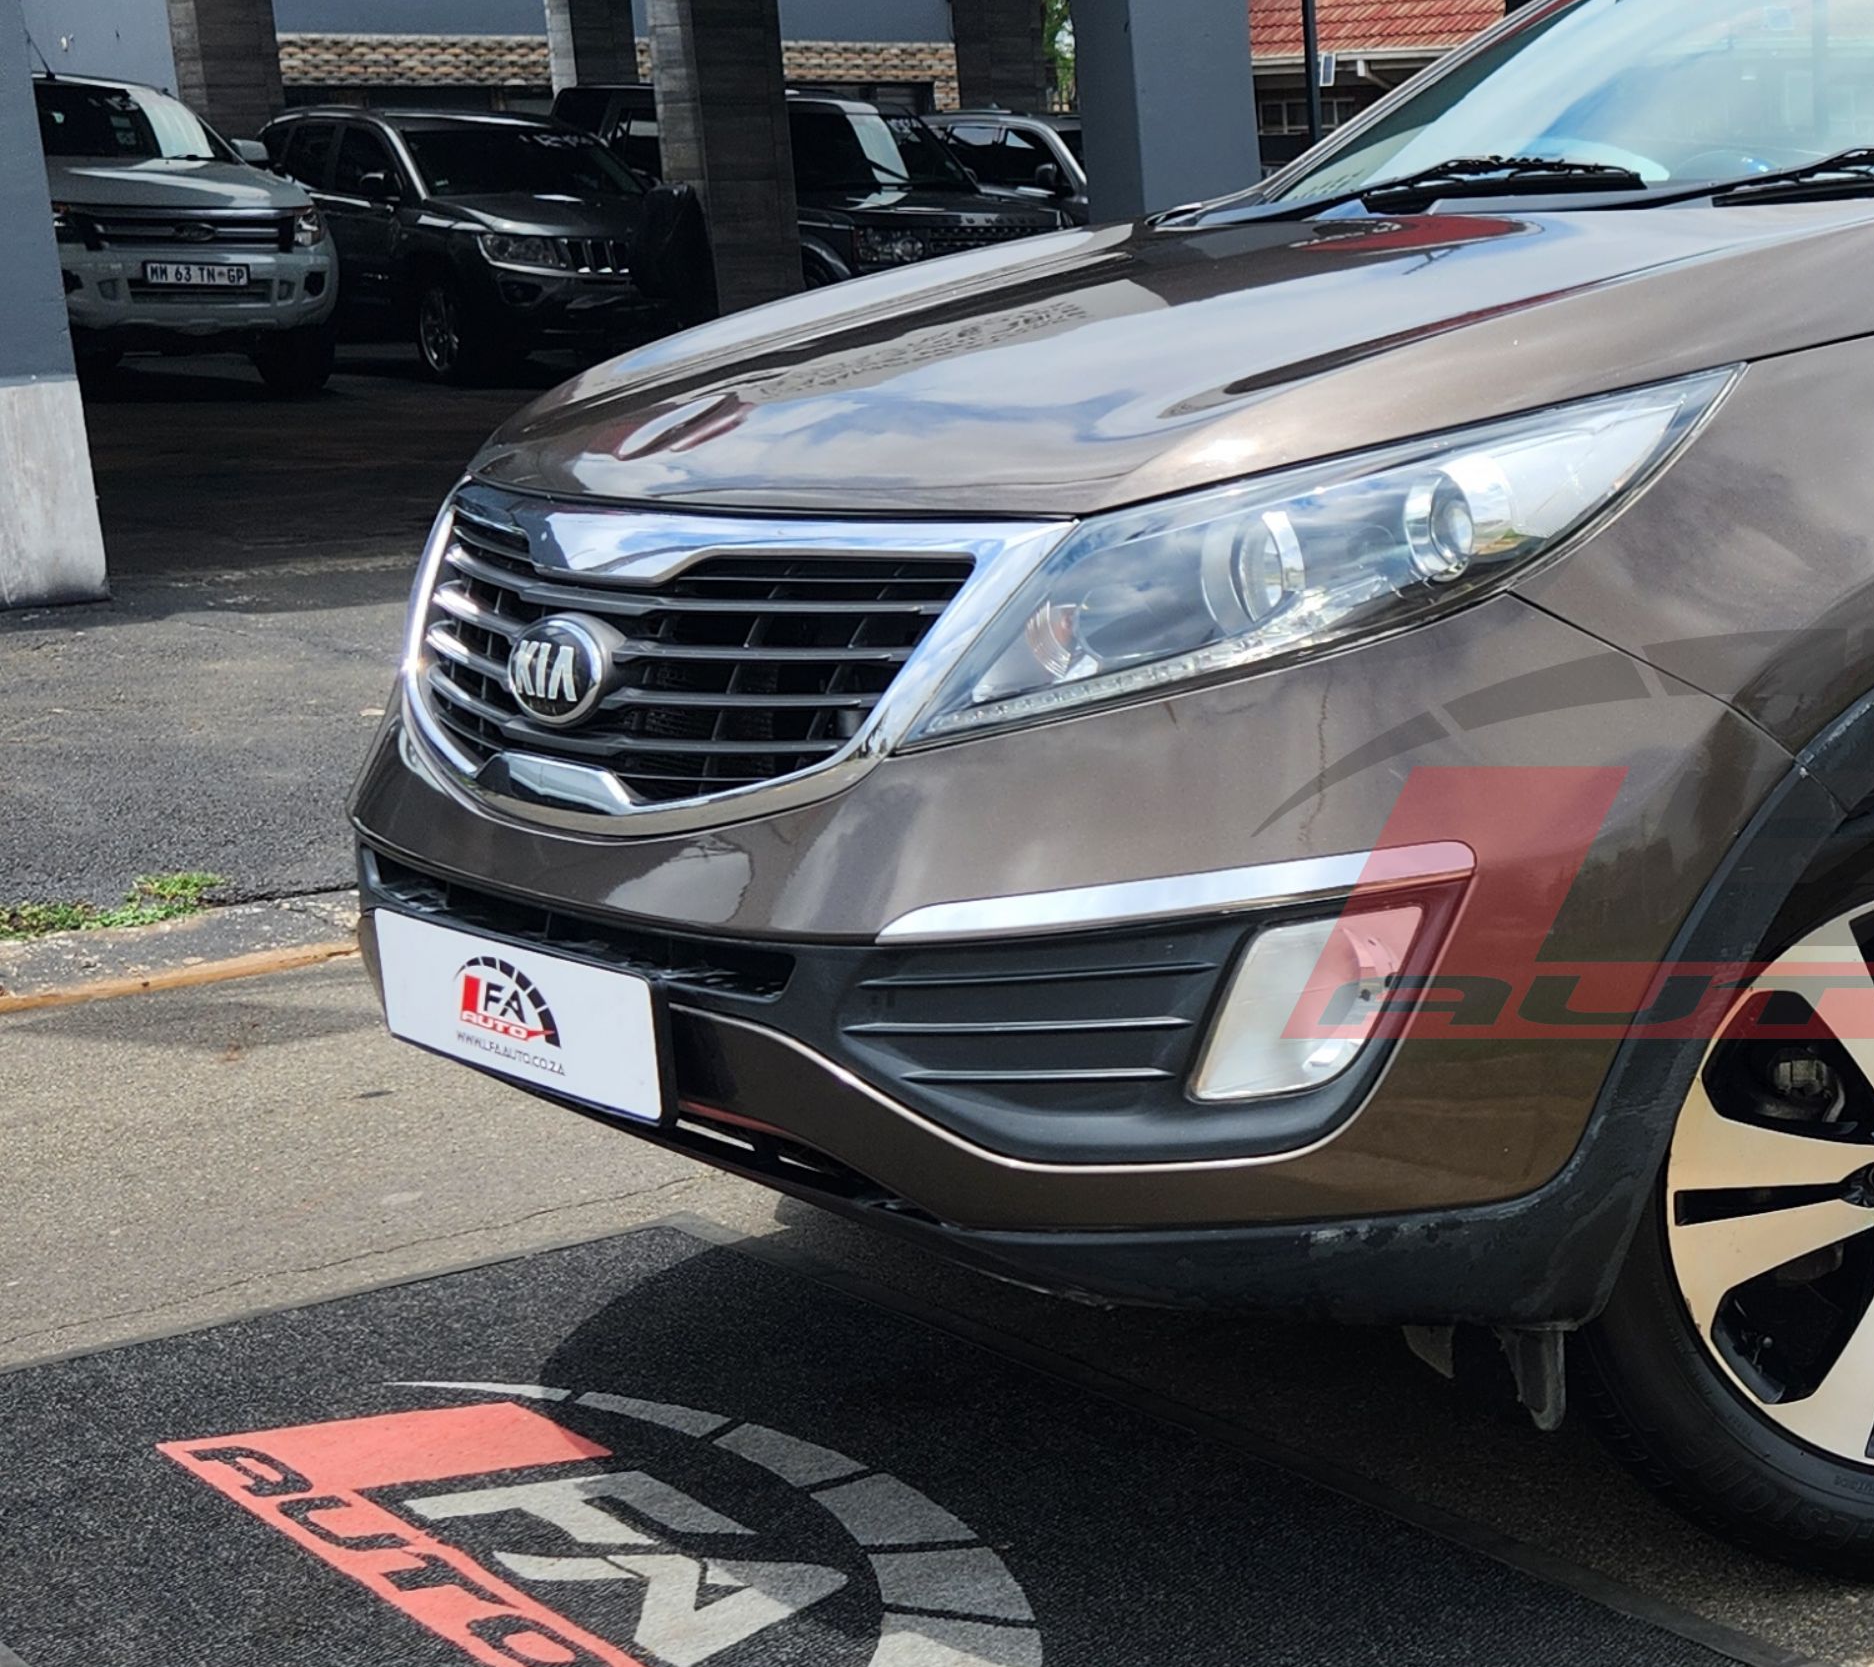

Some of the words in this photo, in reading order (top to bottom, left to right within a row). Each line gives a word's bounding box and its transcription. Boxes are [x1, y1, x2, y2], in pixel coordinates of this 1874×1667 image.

[174, 265, 192, 282] 63
[226, 268, 245, 284] GP
[514, 638, 578, 703] KIA
[461, 1010, 529, 1040] AUTO
